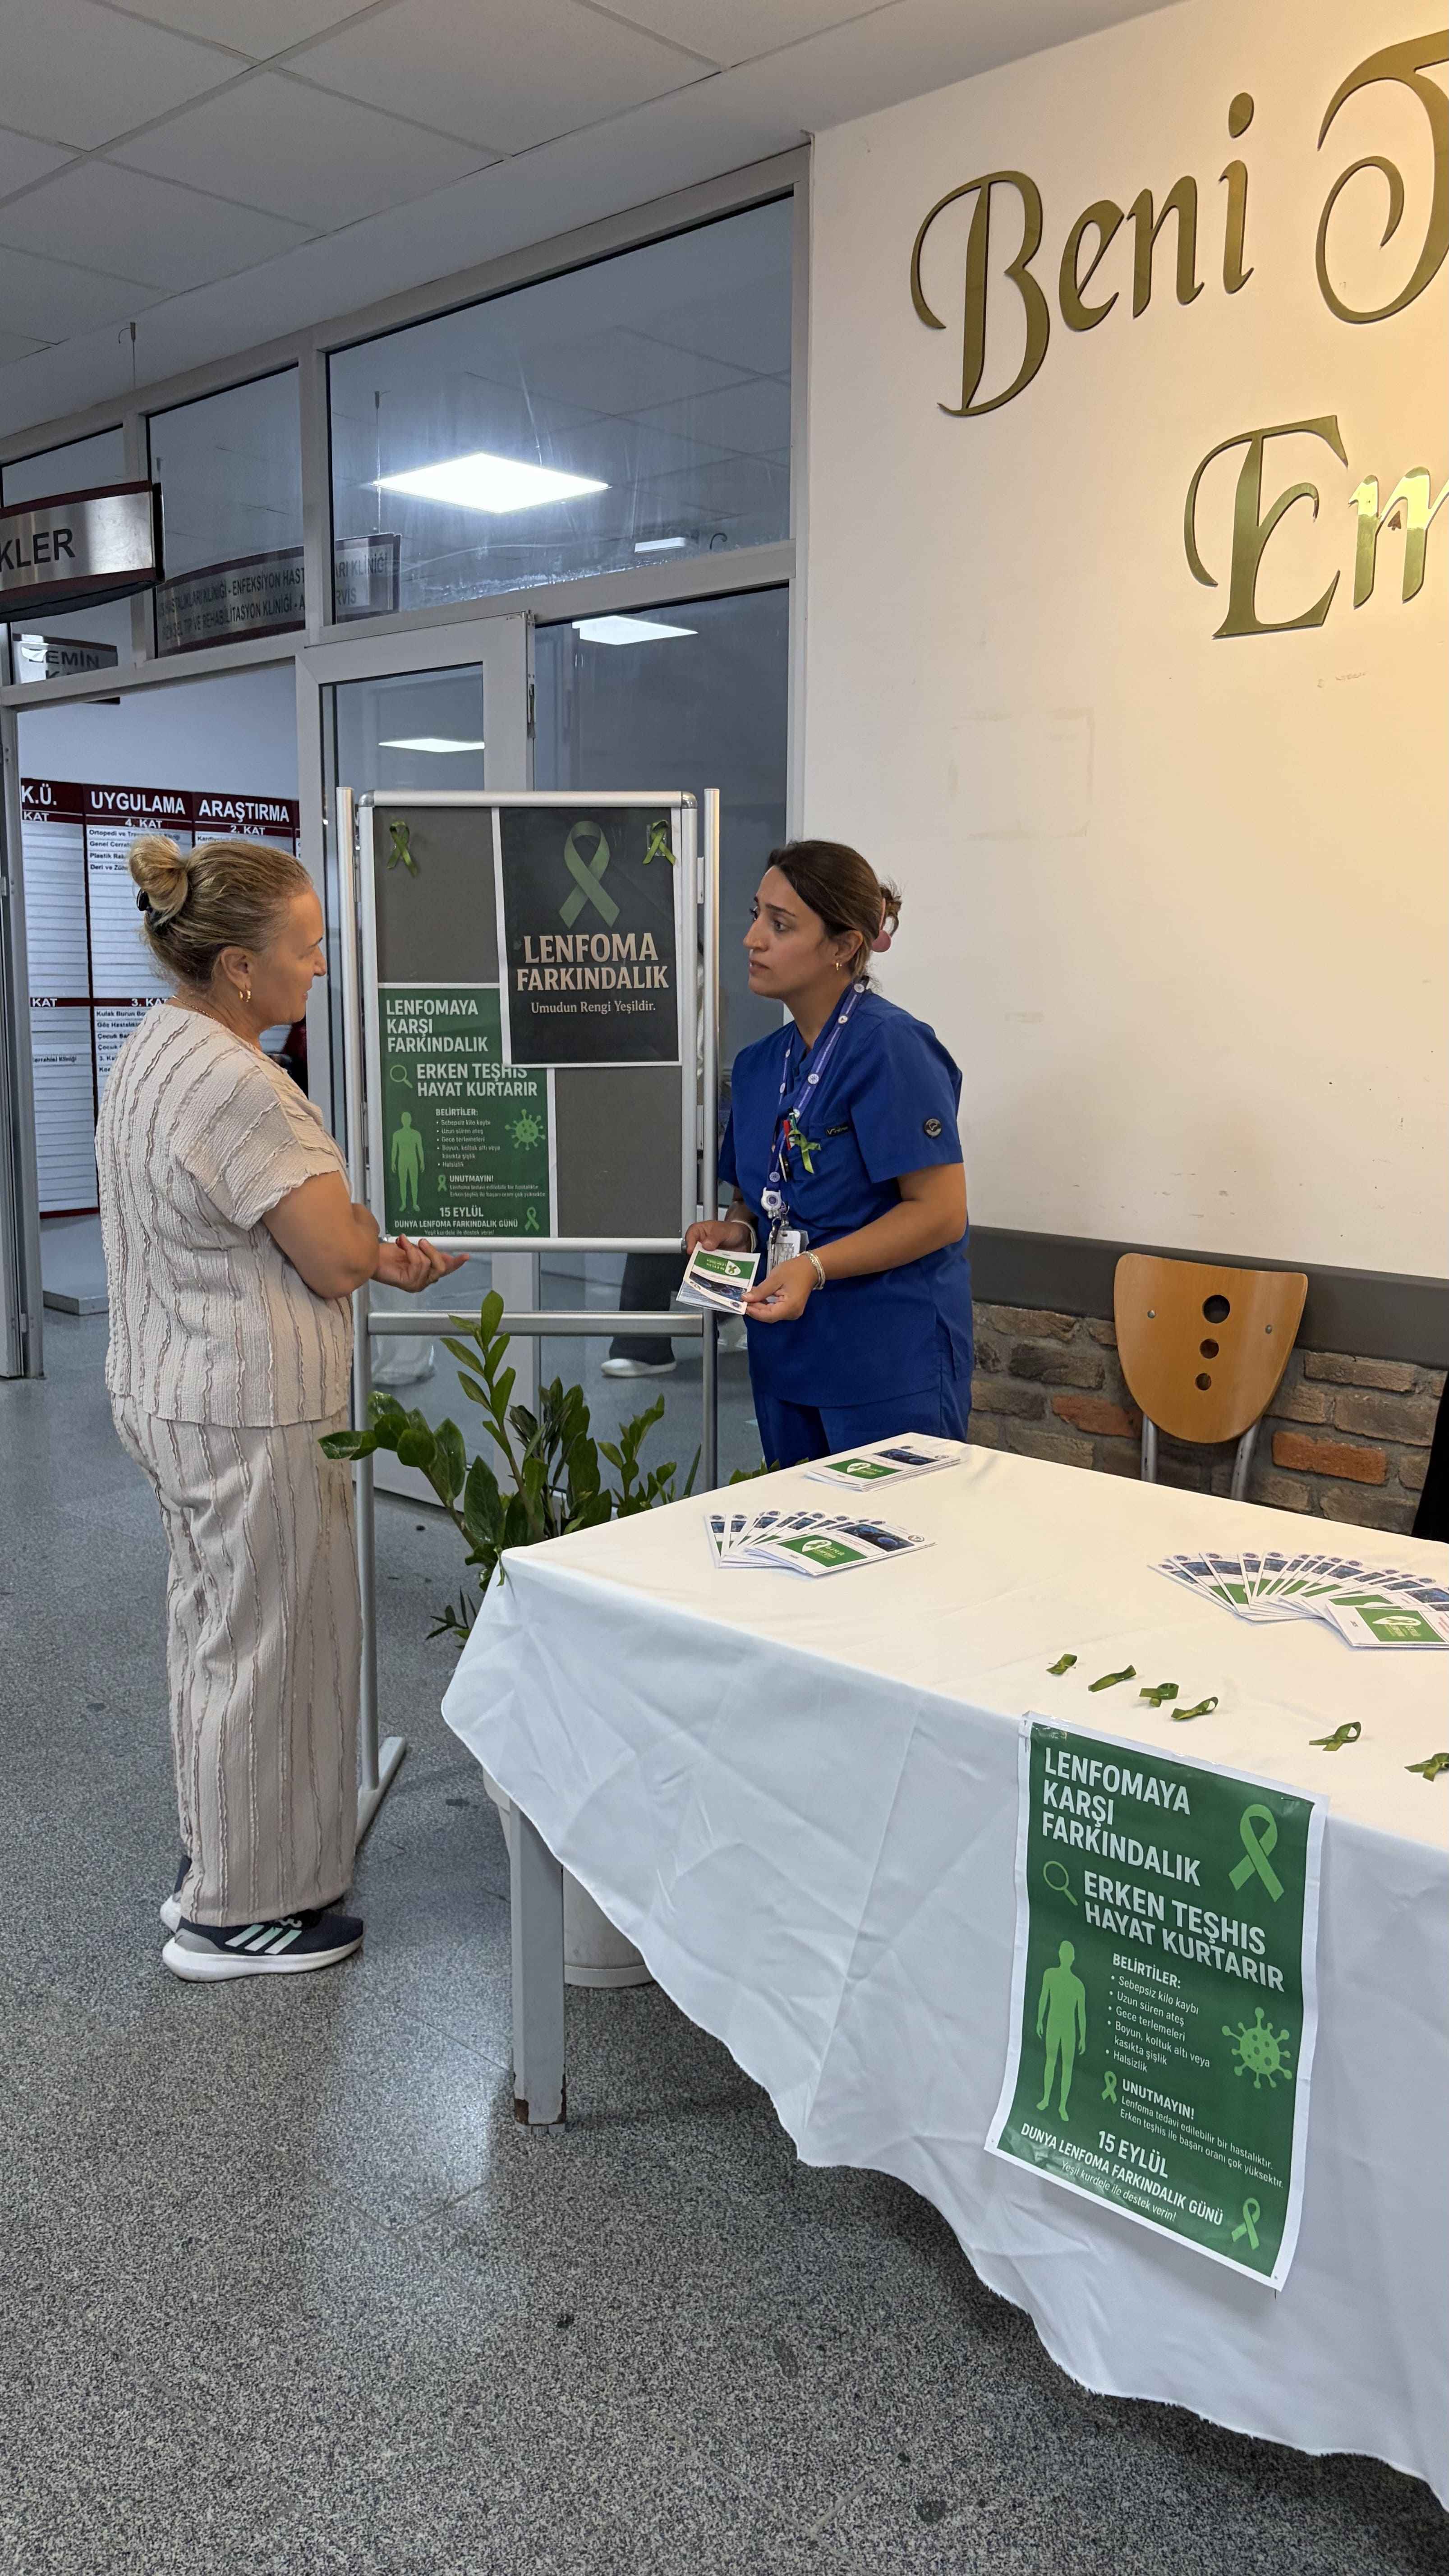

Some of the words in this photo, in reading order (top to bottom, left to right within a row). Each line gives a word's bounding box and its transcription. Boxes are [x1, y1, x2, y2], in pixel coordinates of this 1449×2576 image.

[910, 92, 1255, 417] Beni
[21, 783, 57, 805] K.Ü.
[91, 791, 186, 815] UYGULAMA
[24, 811, 50, 822] KAT
[124, 818, 135, 827] 4.
[139, 819, 163, 829] KAT
[198, 799, 290, 823] ARAŞTIRMA
[230, 825, 240, 834] 2.
[244, 826, 266, 835] KAT
[524, 933, 658, 963] LENFOMA
[517, 966, 669, 991] FARKINDALIK
[32, 998, 57, 1007] KAT
[131, 998, 142, 1007] 3.
[386, 999, 478, 1015] LENFOMAYA
[531, 1002, 577, 1013] Umudun
[580, 1001, 611, 1014] Rengi
[614, 1000, 656, 1014] Yeşildir.
[386, 1018, 433, 1037] KARŞI
[387, 1037, 489, 1053] FARKINDALIK
[417, 1063, 468, 1079] ERKEN
[418, 1082, 463, 1097] HAYAT
[467, 1082, 538, 1097] KURTARIR
[435, 1107, 478, 1116] BELİRTİLER:
[419, 1220, 451, 1228] LENFOMA
[452, 1220, 497, 1228] FARKINDALIK
[498, 1219, 518, 1228] GÜNÜ
[439, 1207, 451, 1217] 15
[453, 1205, 484, 1217] EYLÜL
[1045, 1747, 1190, 1815] LENFOMAYA
[1043, 1779, 1114, 1827] KARŞI
[1042, 1811, 1201, 1886] FARKINDALIK
[1084, 1870, 1164, 1921] ERKEN
[1172, 1899, 1265, 1955] TEŞHIS
[1085, 1901, 1155, 1945] HAYAT
[1162, 1927, 1285, 1992] KURTARIR
[1113, 1953, 1181, 1989] BELİRTİLER:
[1117, 1991, 1138, 2007] Uzun
[1140, 2001, 1164, 2017] süren
[1166, 2011, 1184, 2027] ateş
[1118, 1976, 1156, 1998] Sebepsiz
[1158, 1991, 1173, 2005] kilo
[1175, 1997, 1199, 2015] kaybı
[1116, 2006, 1137, 2021] Gece
[1139, 2015, 1185, 2042] terlemeleri
[1113, 2050, 1147, 2072] Halsizlik
[1114, 2035, 1144, 2055] kasıkta
[1145, 2050, 1167, 2065] şişlik
[1145, 2033, 1172, 2052] koltuk
[1174, 2046, 1187, 2058] altı
[1190, 2053, 1210, 2068] veya
[1122, 2079, 1194, 2120] UNUTMAYIN!
[1120, 2108, 1141, 2125] Erken
[1143, 2119, 1166, 2136] teşhis
[1168, 2130, 1177, 2141] ile
[1179, 2134, 1203, 2153] başarı
[1205, 2148, 1226, 2163] oranı
[1228, 2157, 1242, 2170] çok
[1122, 2096, 1154, 2117] Lenfoma
[1156, 2111, 1179, 2128] tedavi
[1181, 2123, 1215, 2144] edilebilir
[1217, 2137, 1228, 2150] bir
[1230, 2142, 1273, 2170] hastalıktır.
[1099, 2130, 1116, 2153] 15
[1118, 2139, 1168, 2179] EYLÜL
[1021, 2123, 1057, 2149] DUNYA
[1058, 2139, 1109, 2174] LENFOMA
[1111, 2164, 1187, 2209] FARKINDALIK
[1188, 2200, 1224, 2226] GÜNÜ
[1062, 2160, 1080, 2176] Yeşil
[1080, 2170, 1110, 2190] kurdele
[1111, 2184, 1122, 2196] ile
[1122, 2191, 1150, 2211] destek
[1153, 2205, 1177, 2222] verin!
